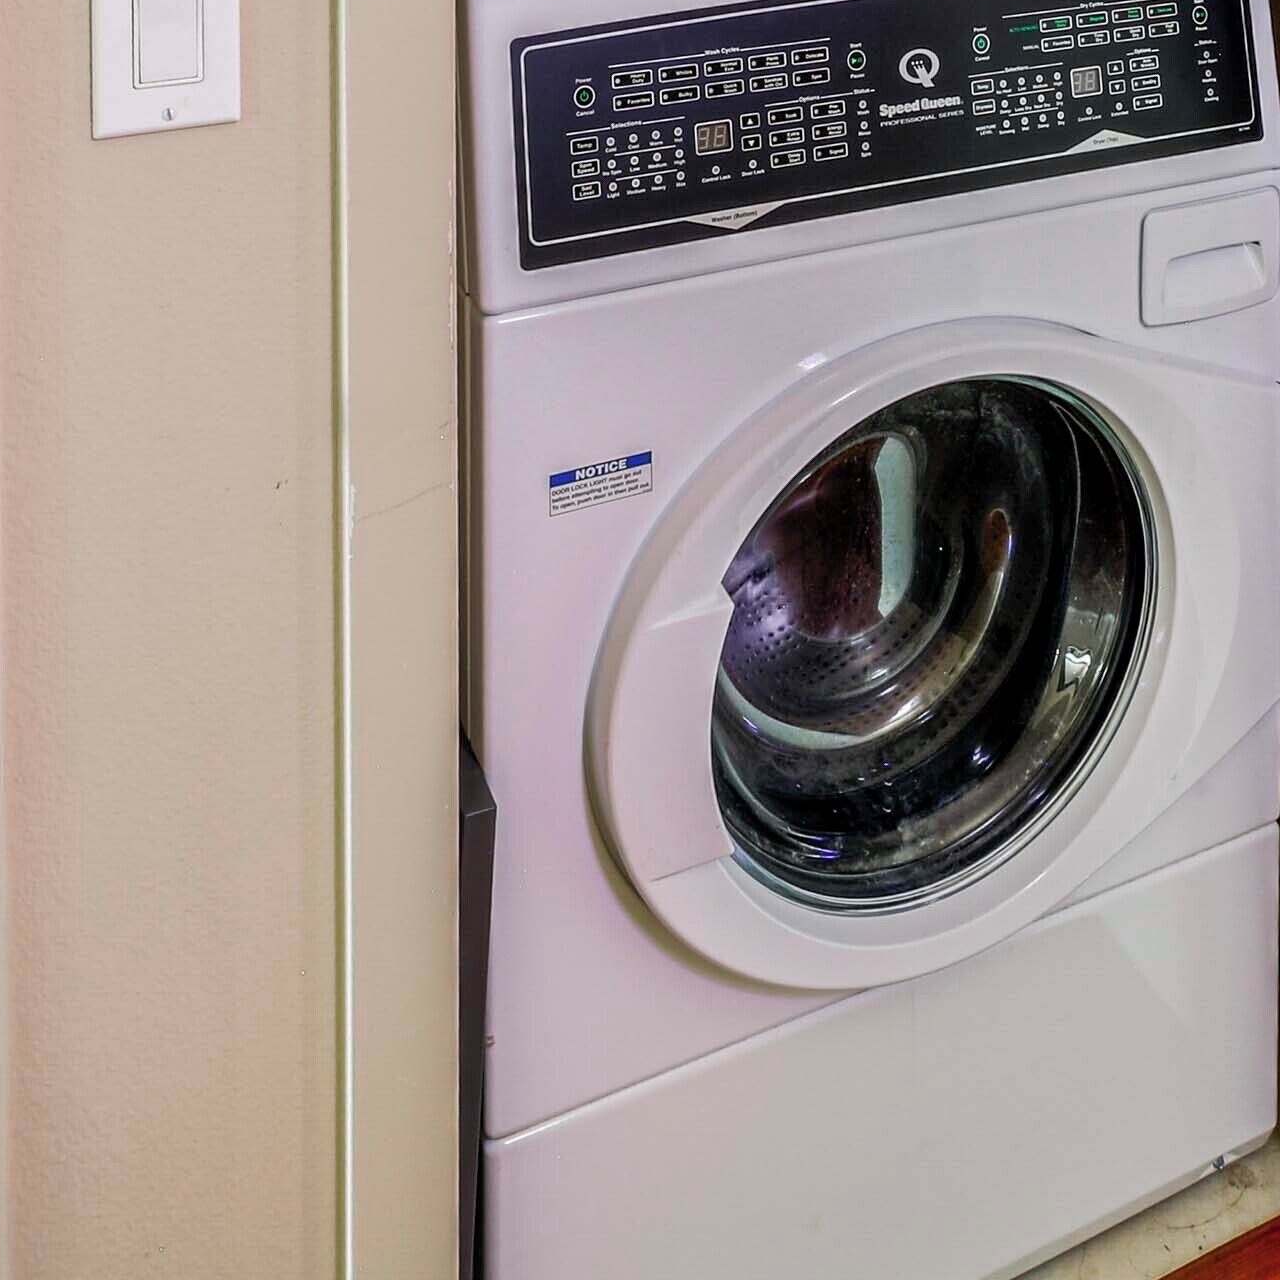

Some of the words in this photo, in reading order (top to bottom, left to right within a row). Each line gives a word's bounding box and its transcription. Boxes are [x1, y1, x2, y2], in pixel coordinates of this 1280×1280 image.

[704, 48, 720, 56] Wash
[720, 47, 740, 55] Cycles
[799, 95, 820, 103] Options
[879, 99, 920, 118] Speed
[920, 96, 961, 110] Queen
[575, 109, 595, 117] Cancel
[880, 114, 937, 127] PROFESSIONAL
[938, 109, 964, 119] SERIES
[610, 120, 642, 130] Selections
[577, 142, 593, 150] Temp
[575, 458, 628, 480] NOTICE
[552, 486, 570, 497] DOOR
[571, 483, 588, 492] LOCK
